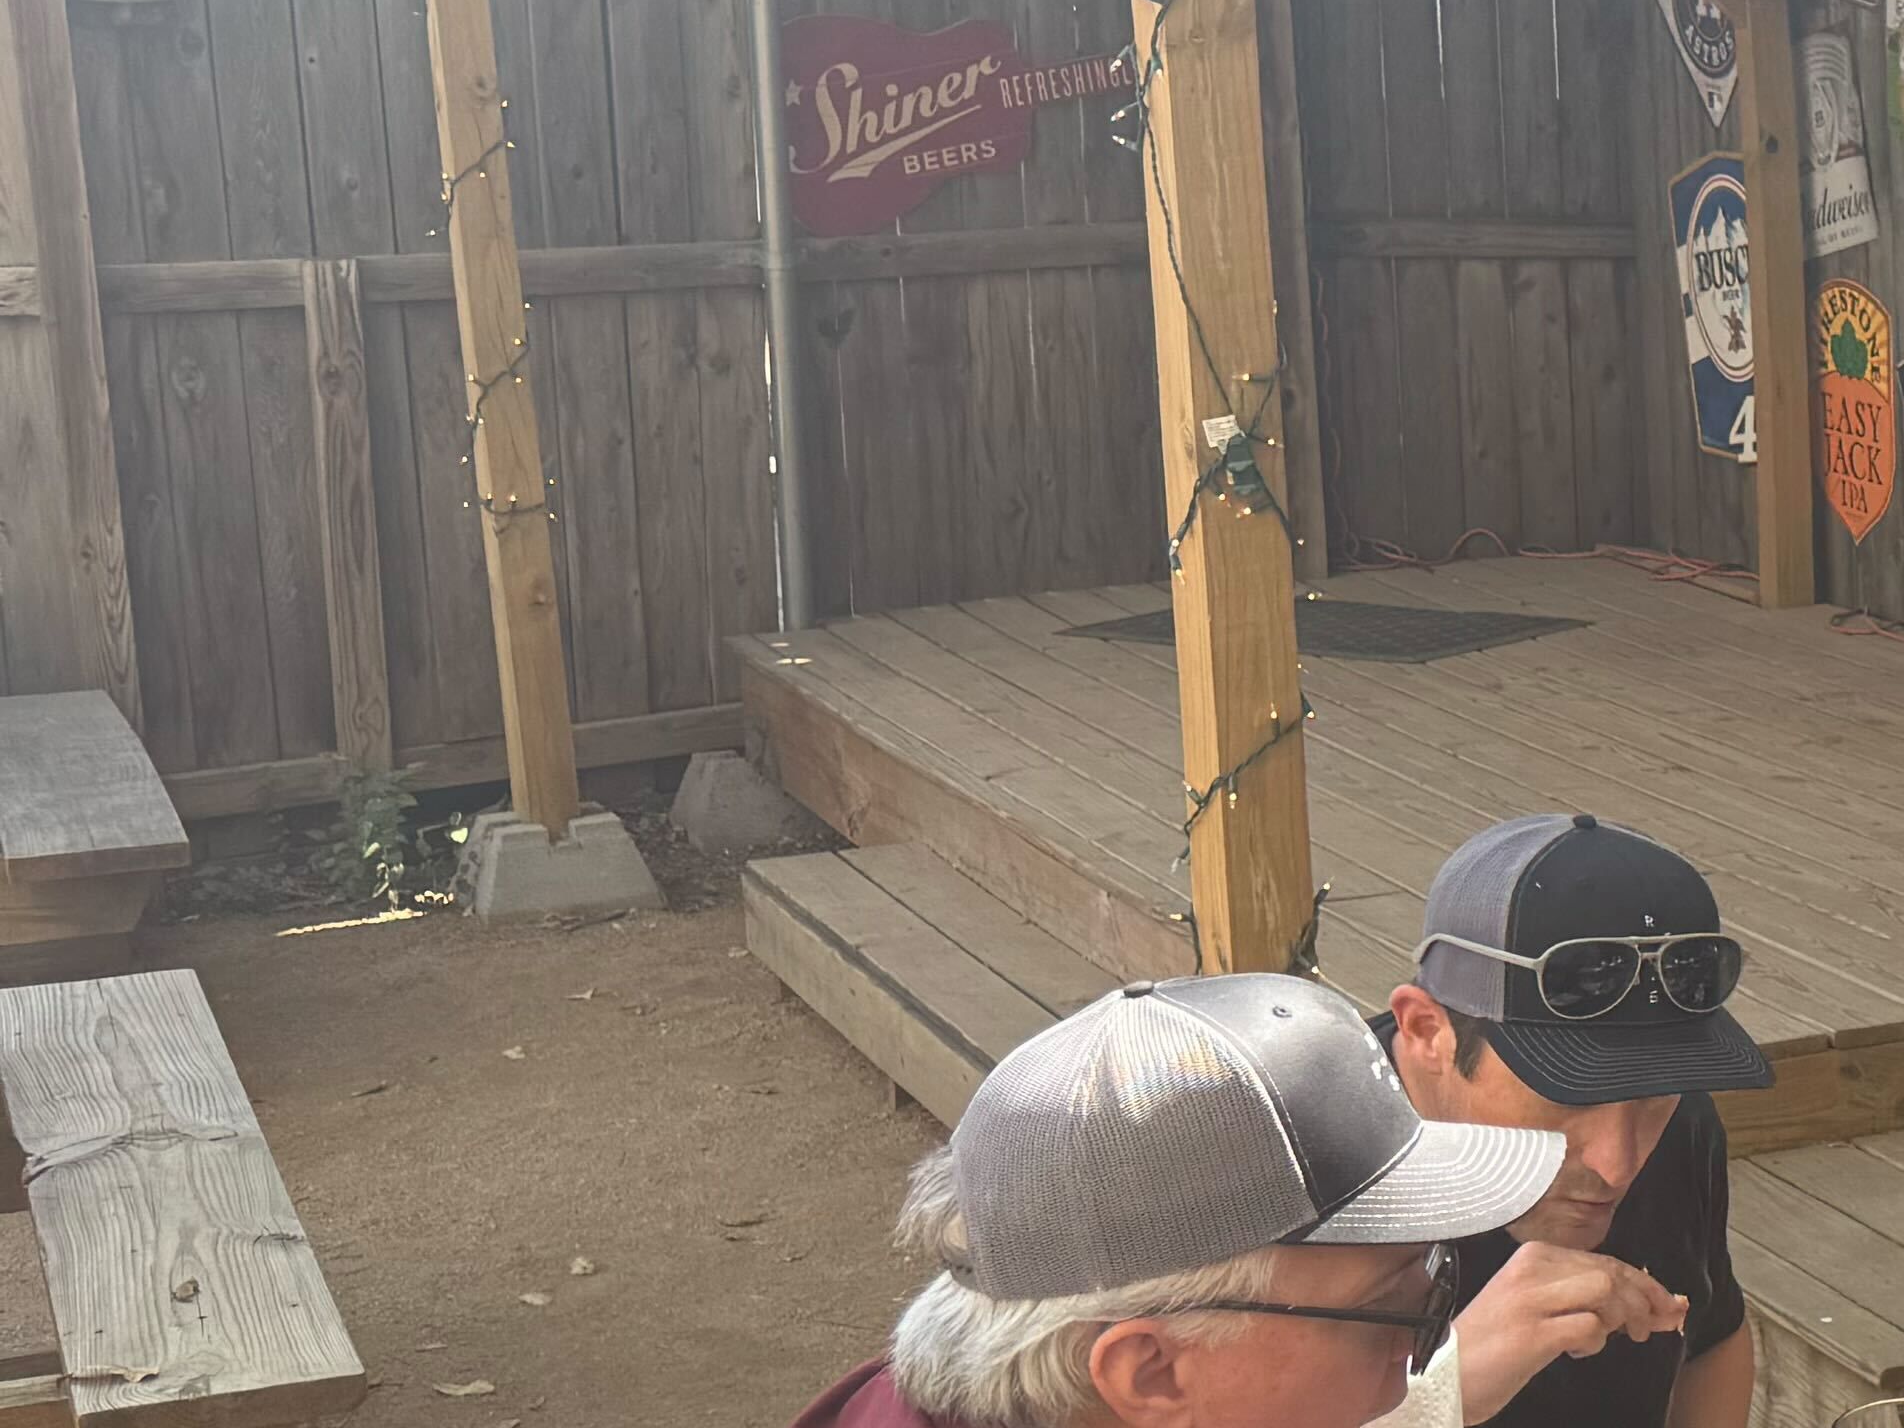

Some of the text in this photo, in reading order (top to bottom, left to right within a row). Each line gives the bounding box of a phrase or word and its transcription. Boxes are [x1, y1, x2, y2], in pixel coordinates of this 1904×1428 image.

[1685, 25, 1734, 67] ASTROS
[1000, 58, 1134, 108] REFRESHINGL
[789, 55, 1002, 175] Shiner
[904, 138, 997, 175] BEERS
[1693, 244, 1749, 293] BUSC
[1822, 391, 1883, 445] EASY
[1823, 432, 1884, 489] JACK
[1838, 479, 1869, 515] IPA
